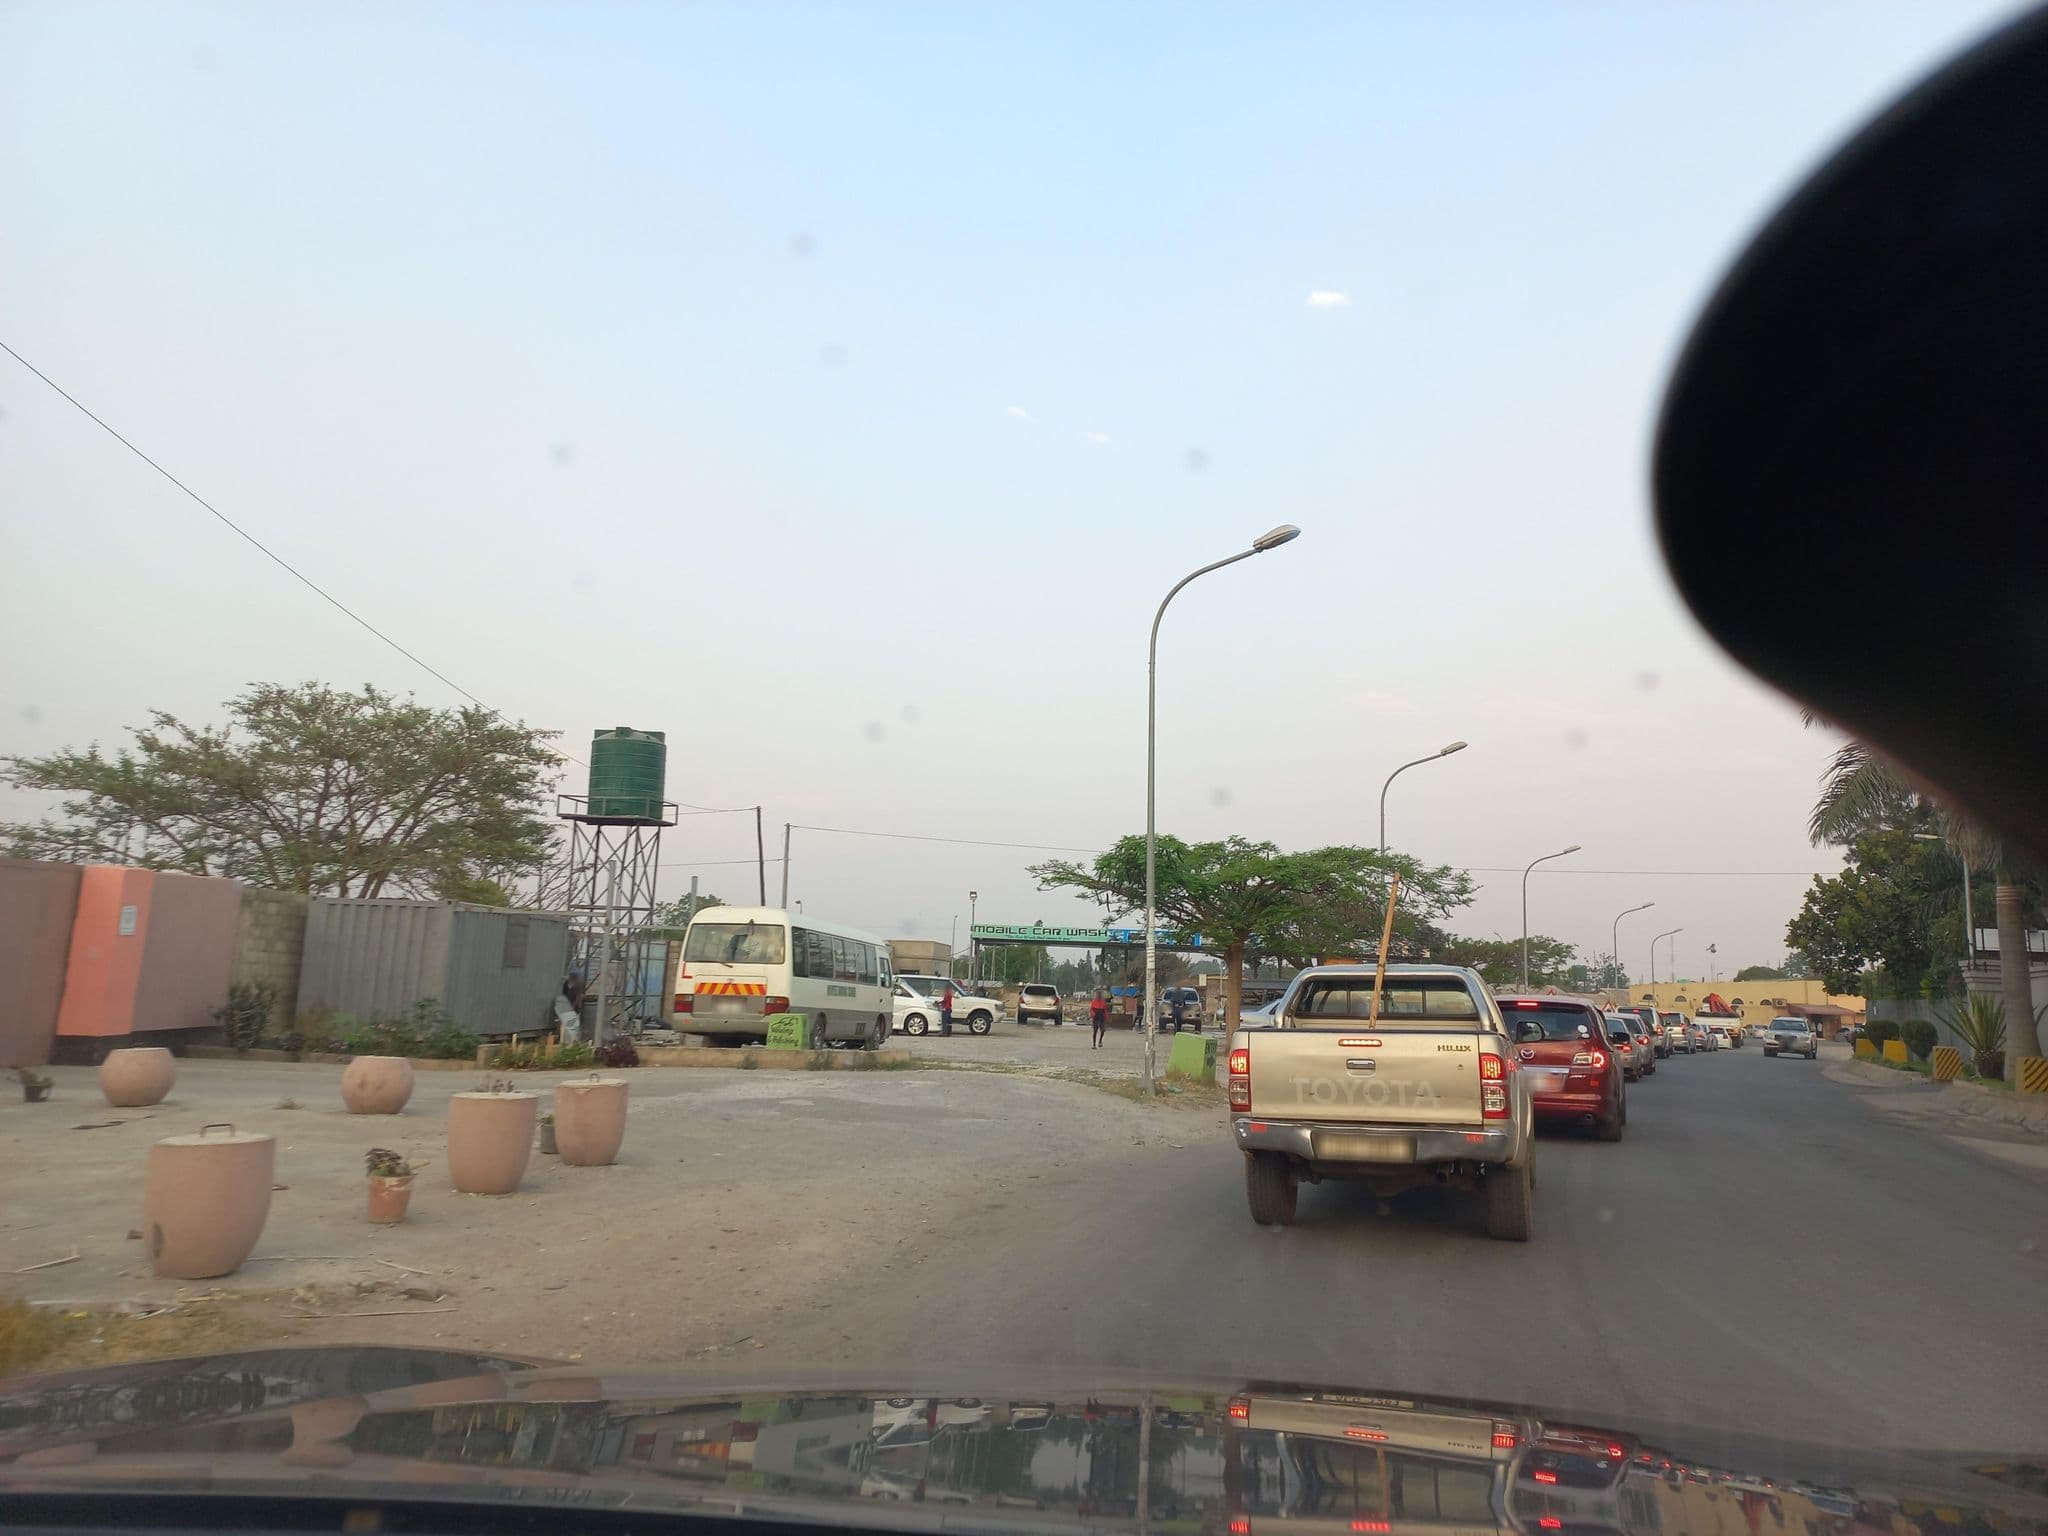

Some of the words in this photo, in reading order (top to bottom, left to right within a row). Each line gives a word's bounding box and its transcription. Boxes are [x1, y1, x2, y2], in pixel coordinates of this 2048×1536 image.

[970, 925, 1027, 935] MOBILE
[1033, 927, 1061, 936] CAR
[1067, 928, 1107, 937] WASH
[1288, 1077, 1441, 1107] TOYOTA
